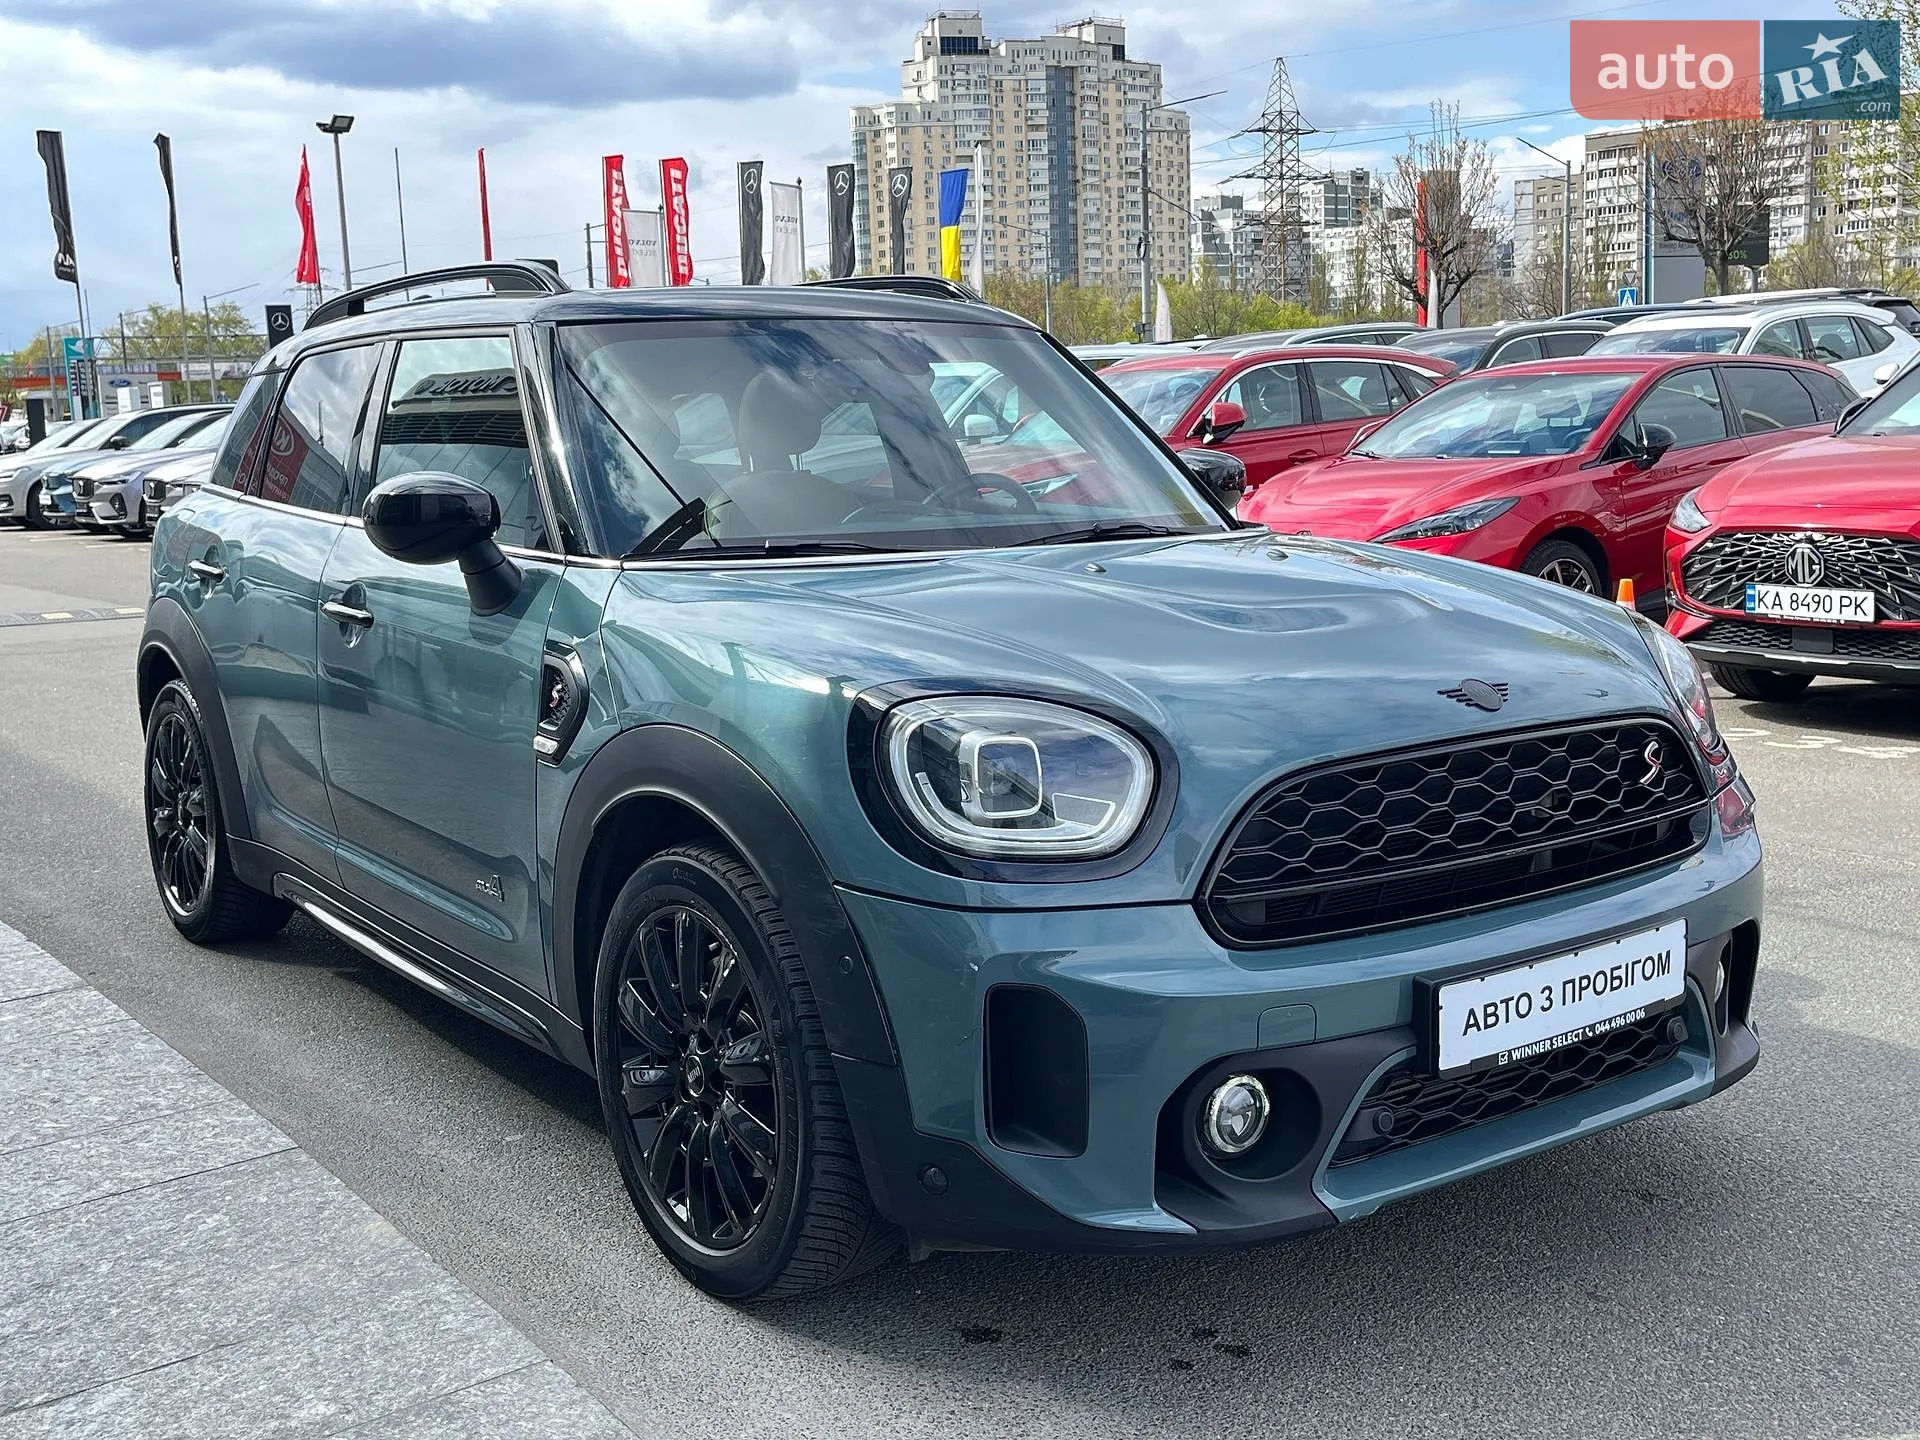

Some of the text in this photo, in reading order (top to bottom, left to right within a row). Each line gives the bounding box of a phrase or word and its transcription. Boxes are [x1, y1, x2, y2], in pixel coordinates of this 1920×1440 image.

[611, 168, 629, 276] DUCATI
[669, 167, 689, 275] DUCATI
[1788, 547, 1821, 583] MG
[1757, 589, 1868, 617] KA 8490 PK
[1639, 740, 1660, 785] S
[1462, 992, 1533, 1036] АВТО
[1561, 949, 1671, 1007] ПРОБІГОМ
[1511, 1007, 1646, 1061] WINNER SELECT 044 496 00 06
